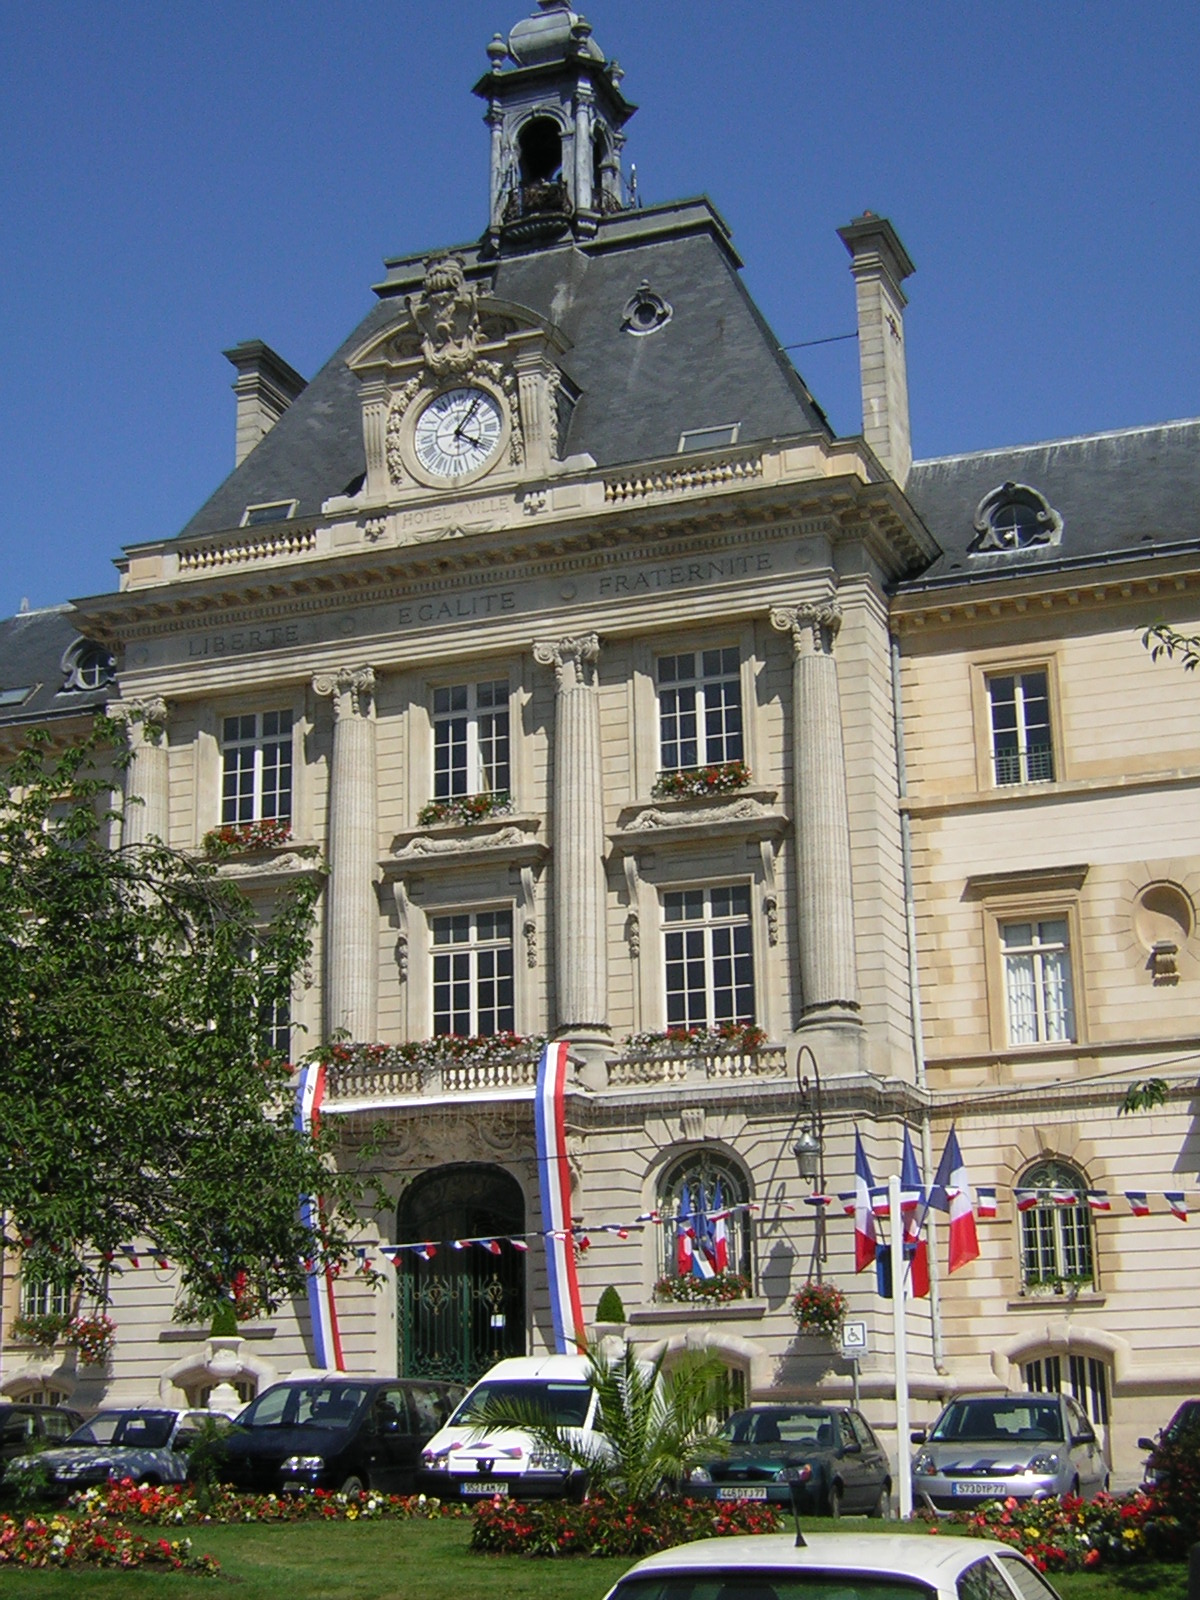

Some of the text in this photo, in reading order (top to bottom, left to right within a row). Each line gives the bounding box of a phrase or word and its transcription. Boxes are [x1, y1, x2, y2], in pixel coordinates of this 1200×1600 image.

[401, 507, 451, 529] HOTEL
[465, 497, 509, 514] VILLE
[188, 552, 773, 656] LIBERTE EGALITE FRATERNITE
